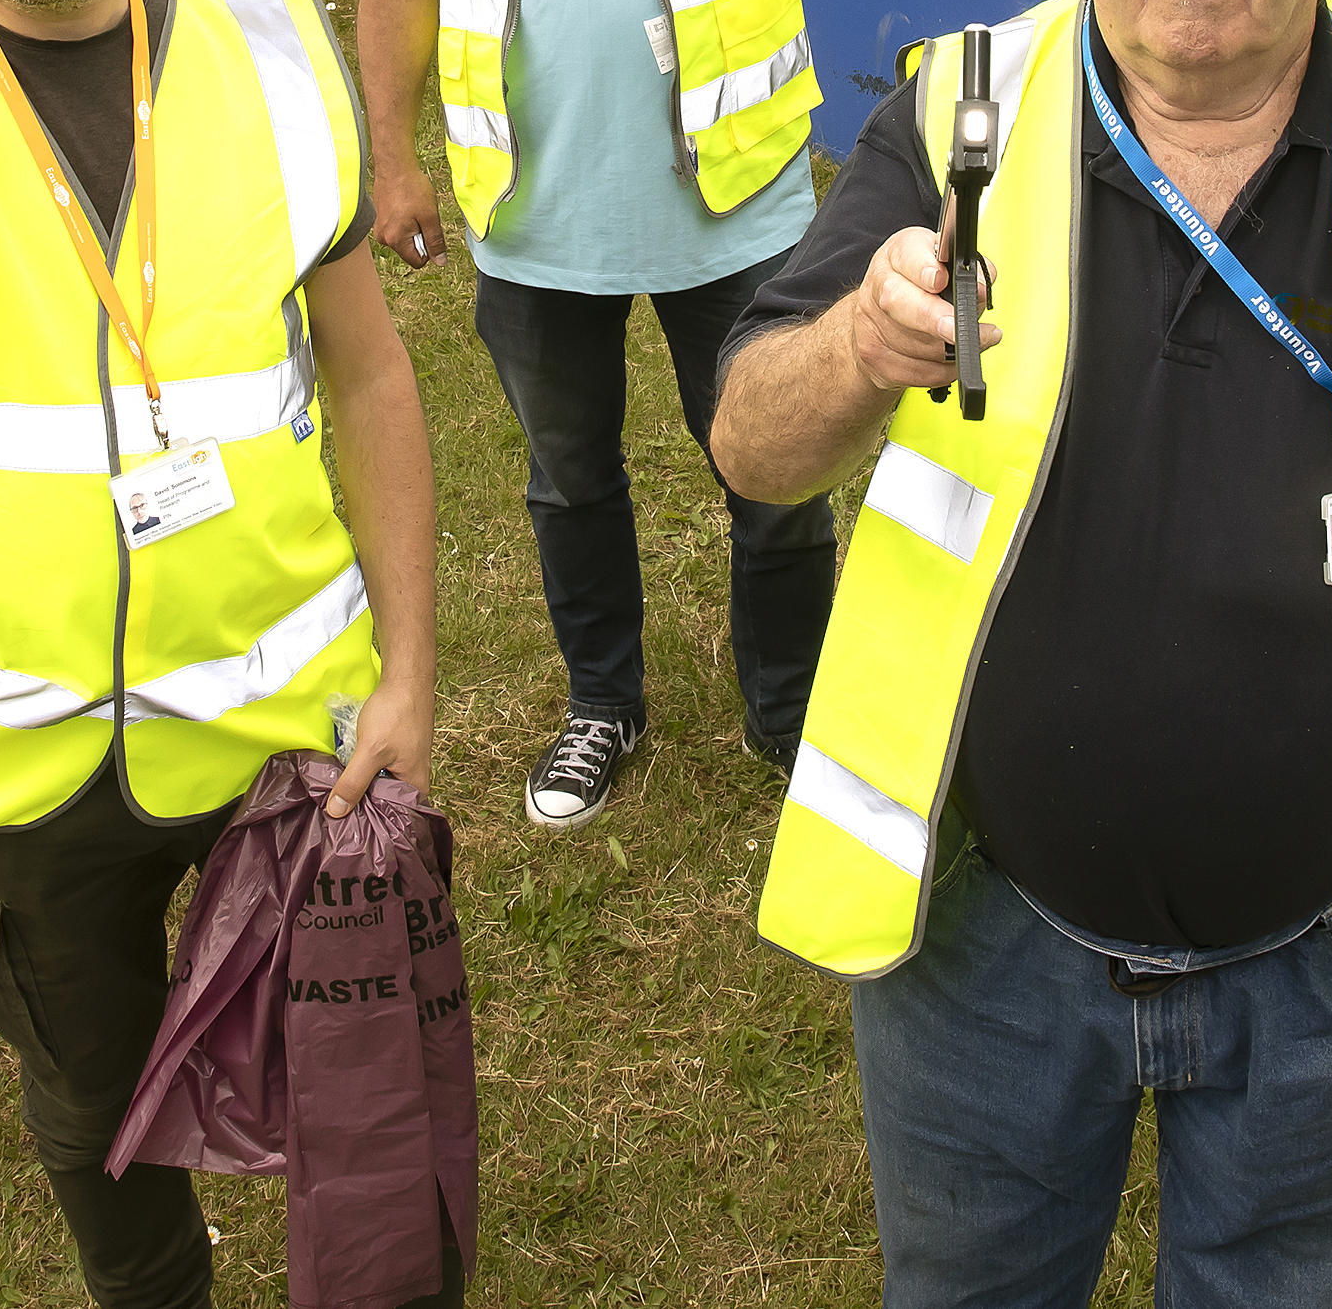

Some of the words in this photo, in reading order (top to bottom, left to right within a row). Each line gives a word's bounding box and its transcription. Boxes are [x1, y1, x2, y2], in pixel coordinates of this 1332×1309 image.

[1088, 63, 1123, 140] Volunteer
[45, 166, 71, 207] Eastlight
[1150, 177, 1220, 257] Volunteer
[1250, 295, 1322, 375] Volunteer
[296, 904, 385, 931] Council
